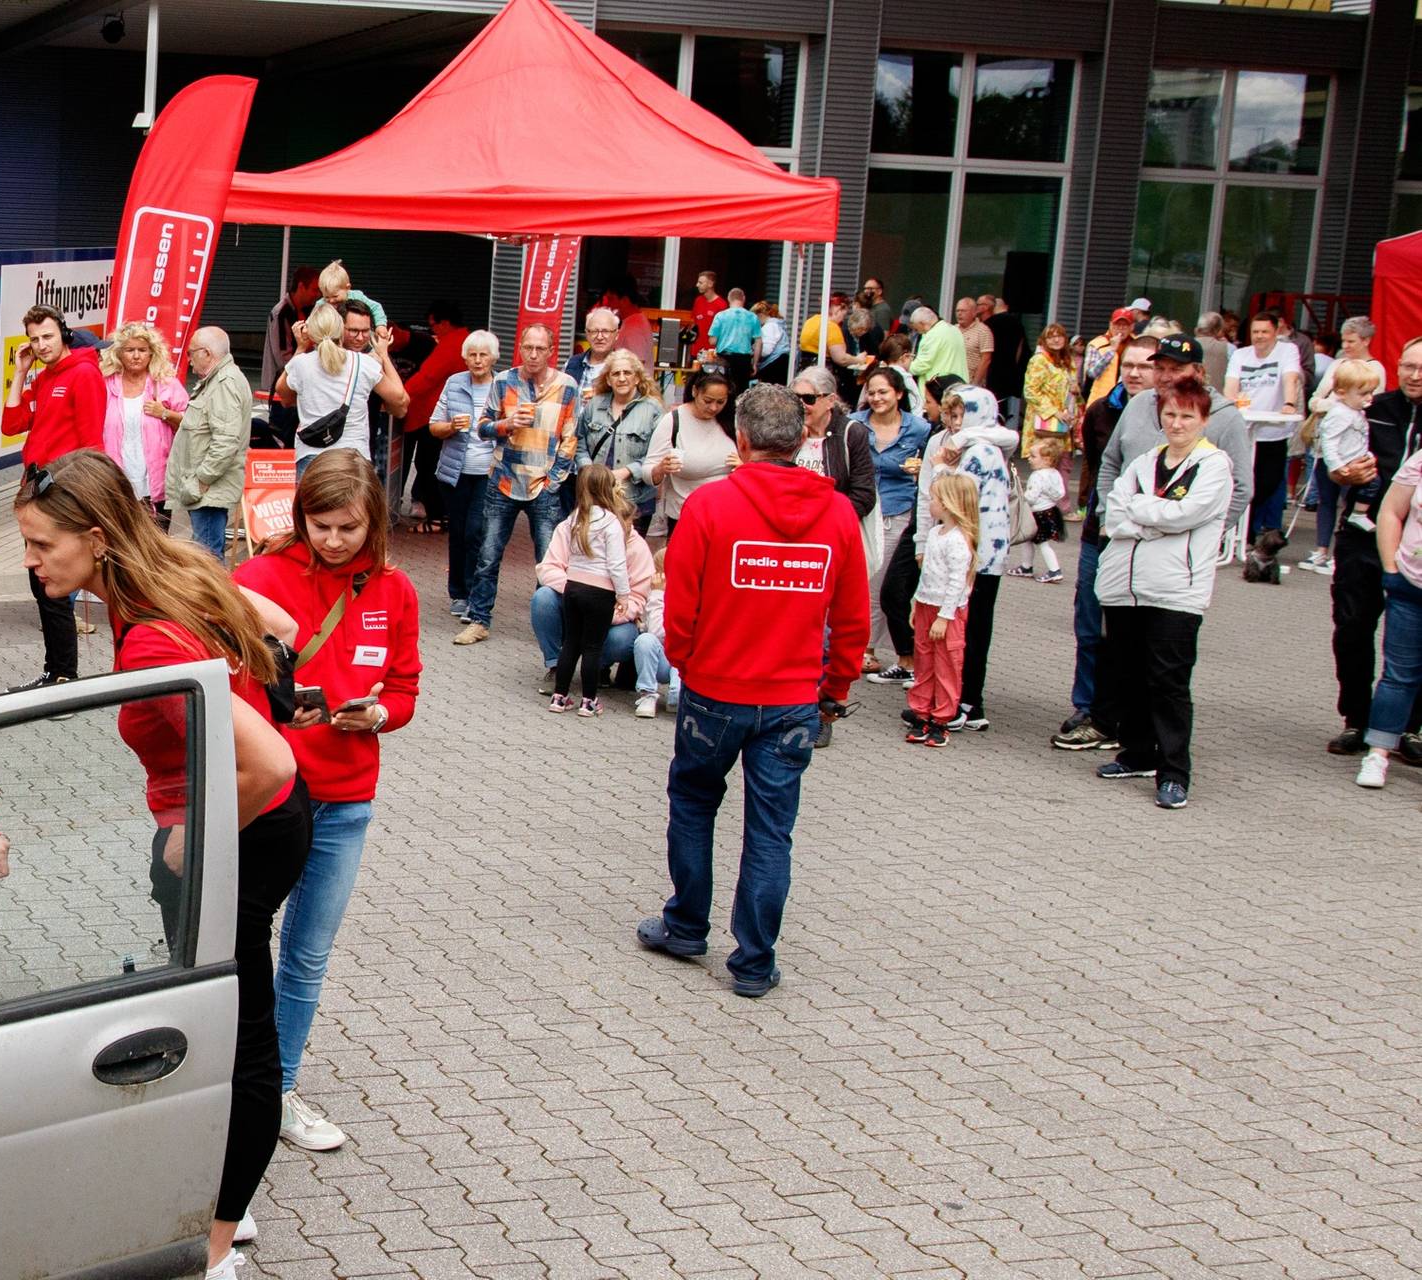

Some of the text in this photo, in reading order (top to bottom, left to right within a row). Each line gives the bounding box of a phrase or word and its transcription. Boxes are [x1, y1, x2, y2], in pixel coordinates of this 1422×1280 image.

[36, 271, 113, 320] Öffnungszei
[539, 271, 552, 306] radio
[252, 498, 292, 519] WISH
[264, 513, 294, 530] YOU
[739, 557, 823, 570] radio essen
